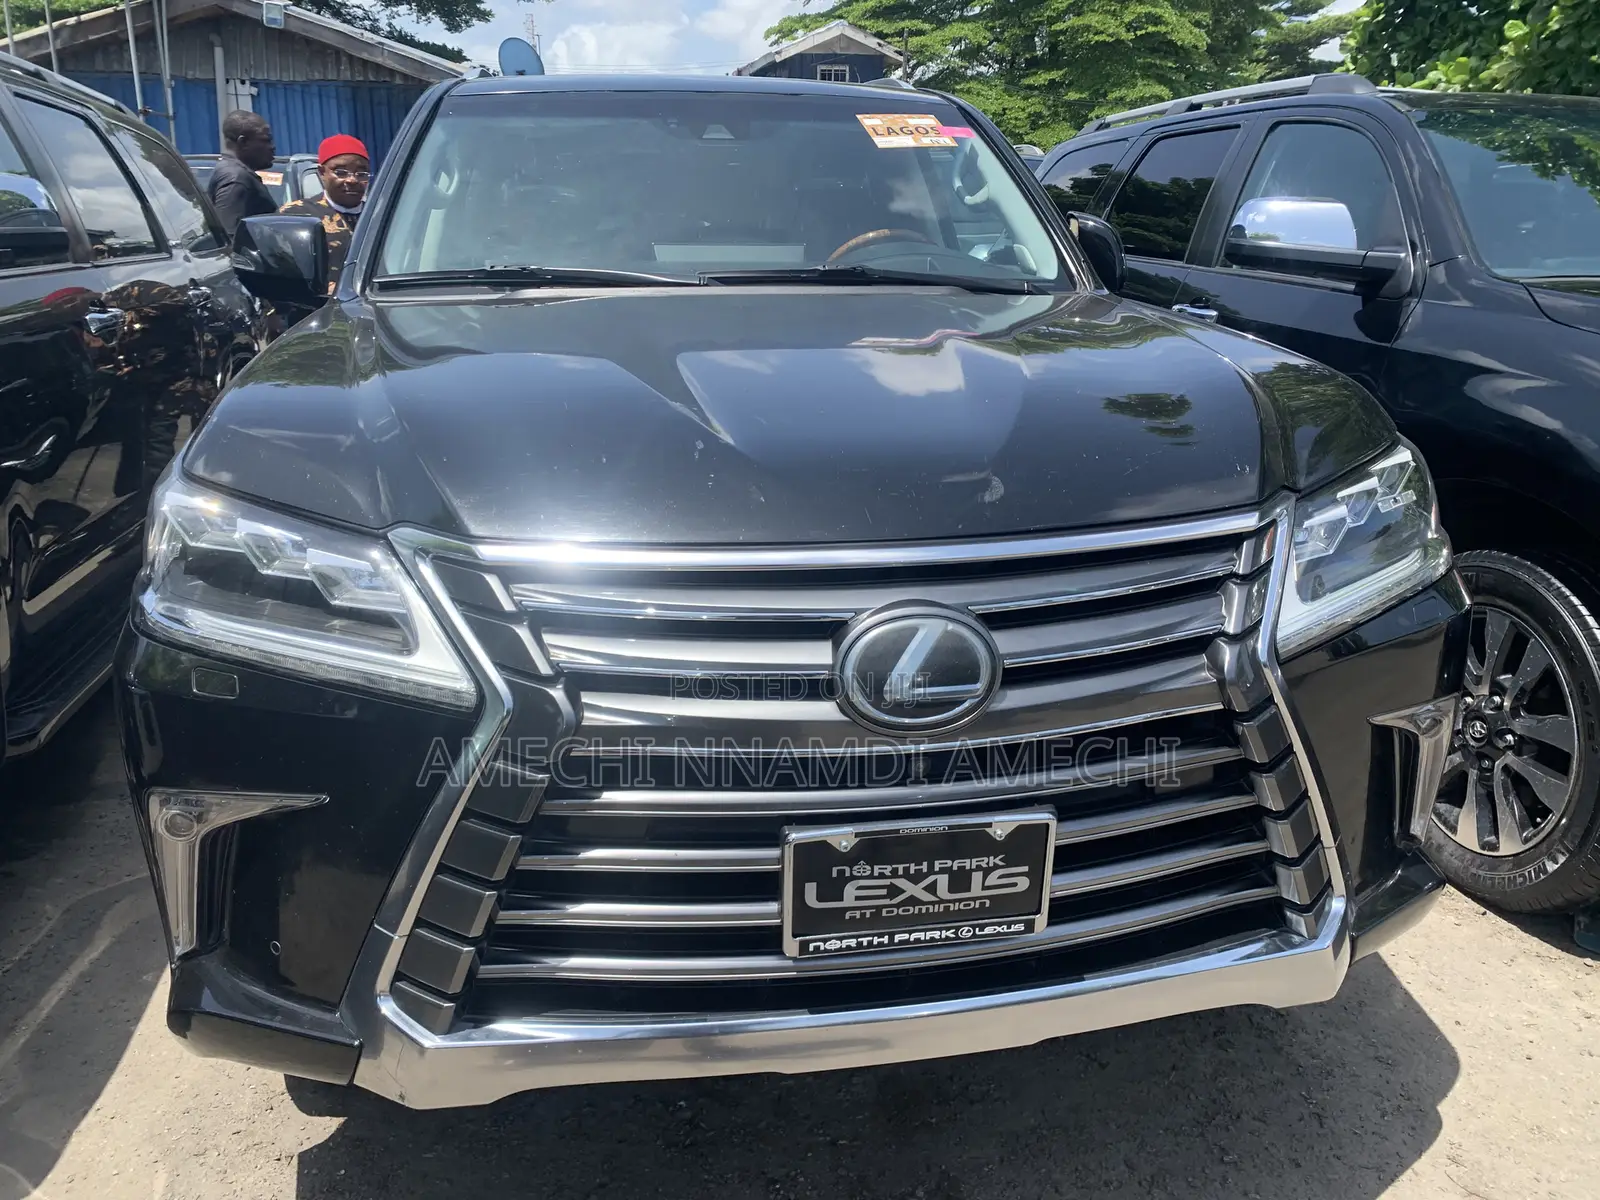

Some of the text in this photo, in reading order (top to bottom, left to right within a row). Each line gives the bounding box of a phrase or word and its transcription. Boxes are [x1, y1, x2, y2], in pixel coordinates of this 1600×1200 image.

[871, 126, 941, 136] LAGOS
[899, 825, 949, 834] DOMINION
[934, 854, 1006, 872] PARK
[804, 866, 1030, 909] LEXUS
[845, 898, 990, 920] AT DOMINION
[894, 928, 956, 944] PARK
[975, 923, 1025, 936] LEXUS
